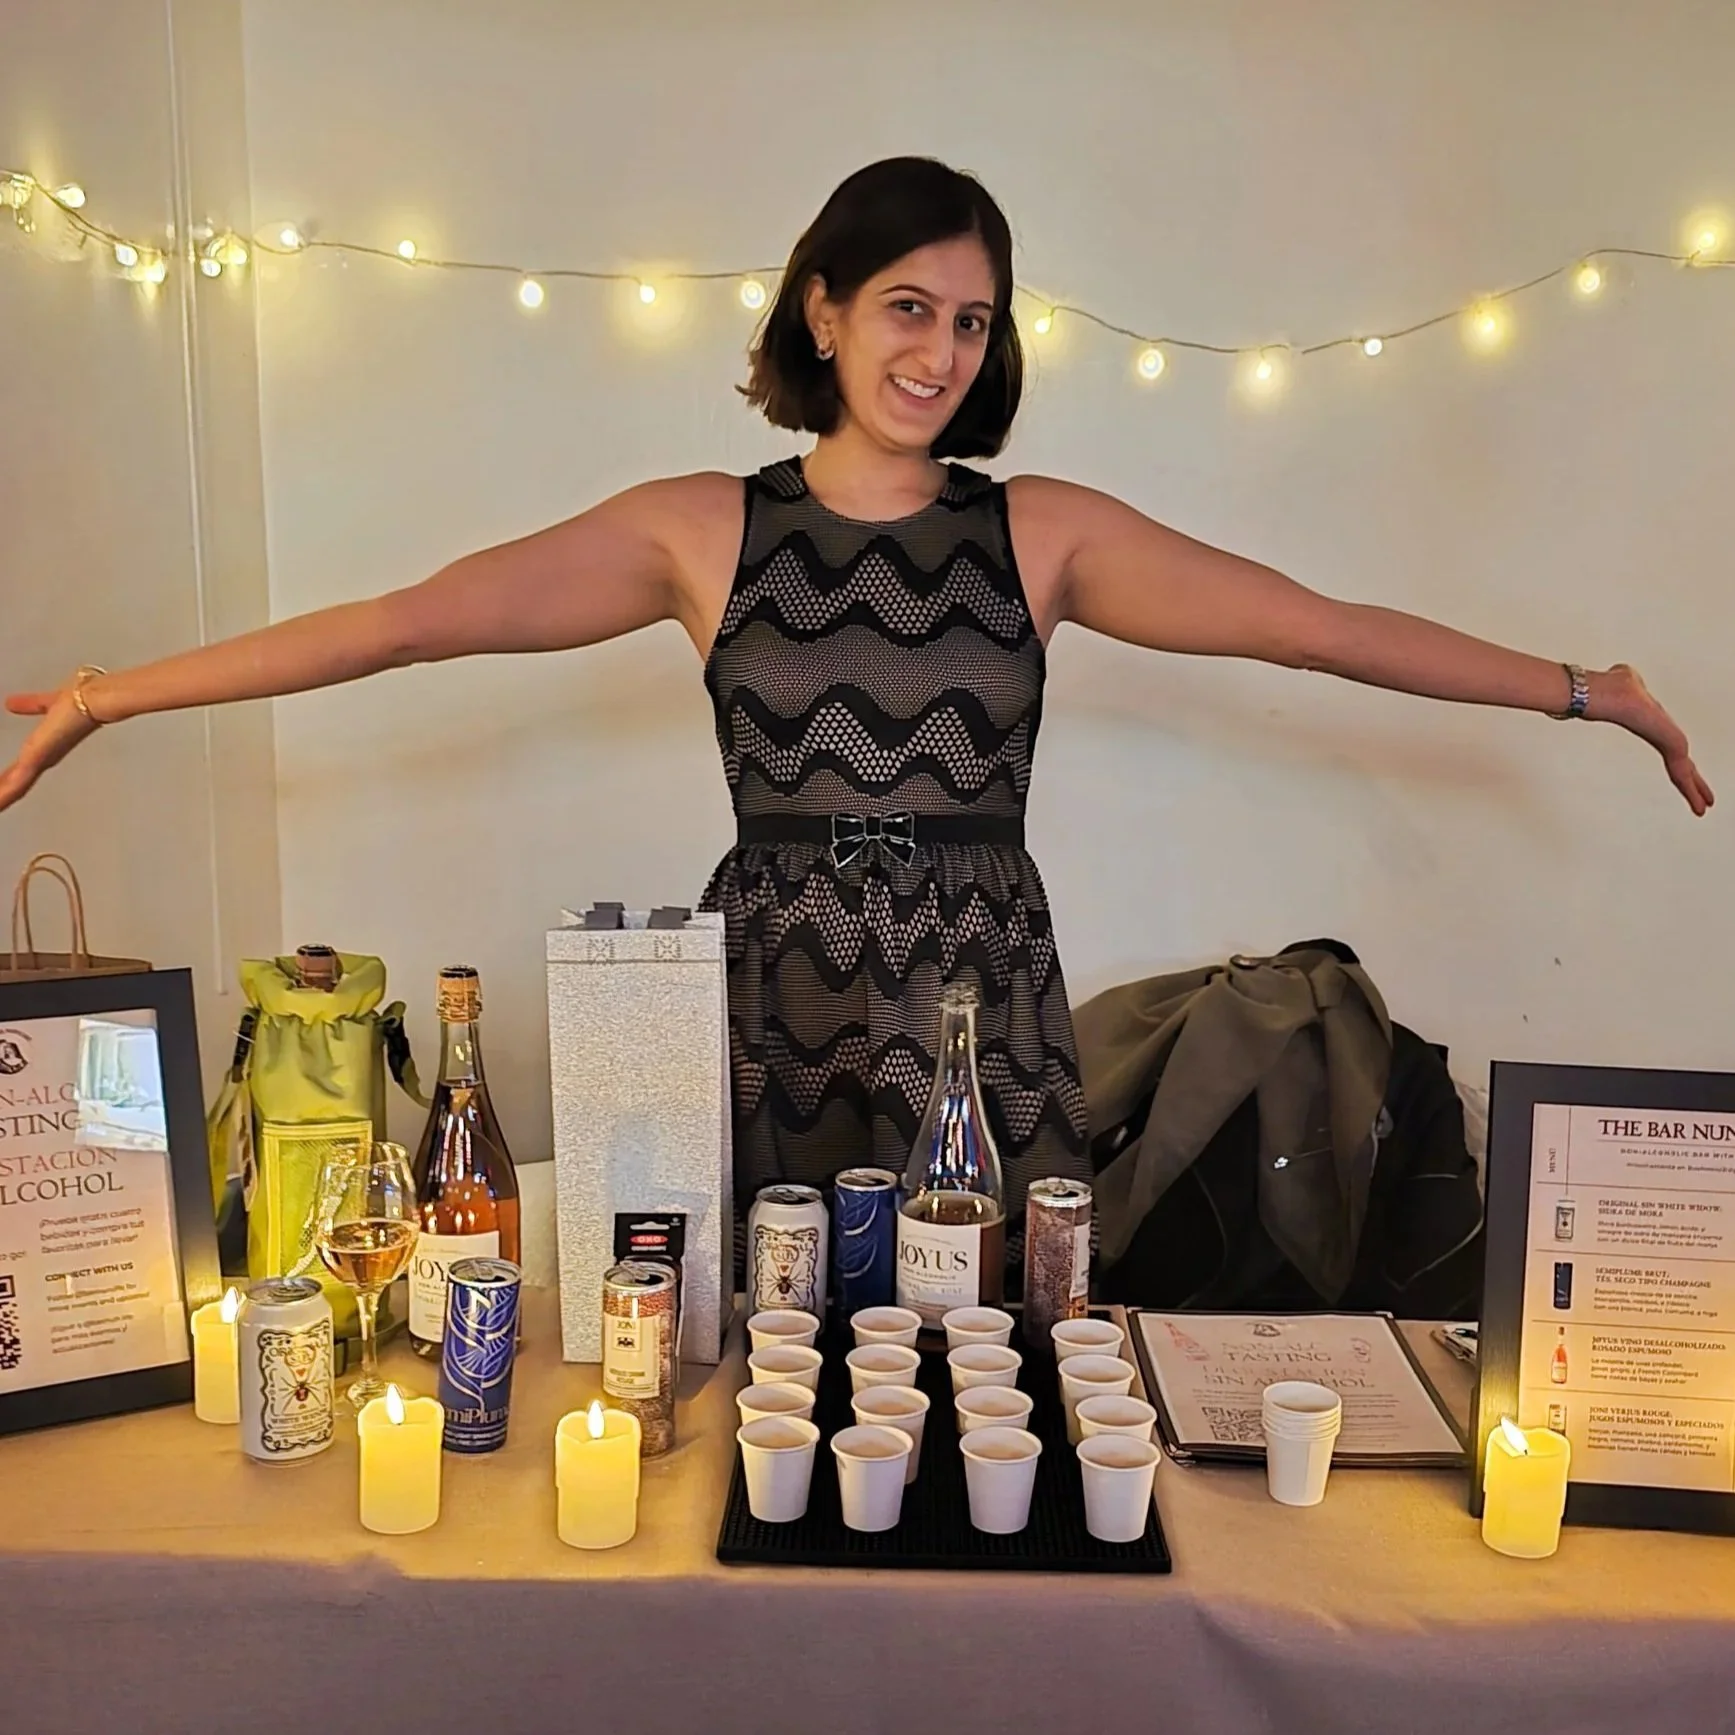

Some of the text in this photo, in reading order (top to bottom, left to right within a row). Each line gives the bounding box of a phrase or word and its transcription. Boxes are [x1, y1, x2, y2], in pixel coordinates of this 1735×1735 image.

[1598, 1119, 1642, 1137] THE
[1648, 1121, 1687, 1139] BAR
[1598, 1199, 1638, 1209] ORIGINAL
[1640, 1201, 1656, 1209] SIN
[1657, 1202, 1686, 1211] WHITE
[636, 1234, 662, 1245] OXO
[93, 1263, 119, 1276] WITH
[120, 1262, 134, 1271] US
[1659, 1279, 1712, 1289] CHAMPAGNE
[1227, 1352, 1332, 1363] TASTING
[1203, 1375, 1245, 1386] SIN
[1588, 1414, 1615, 1423] JUGOS
